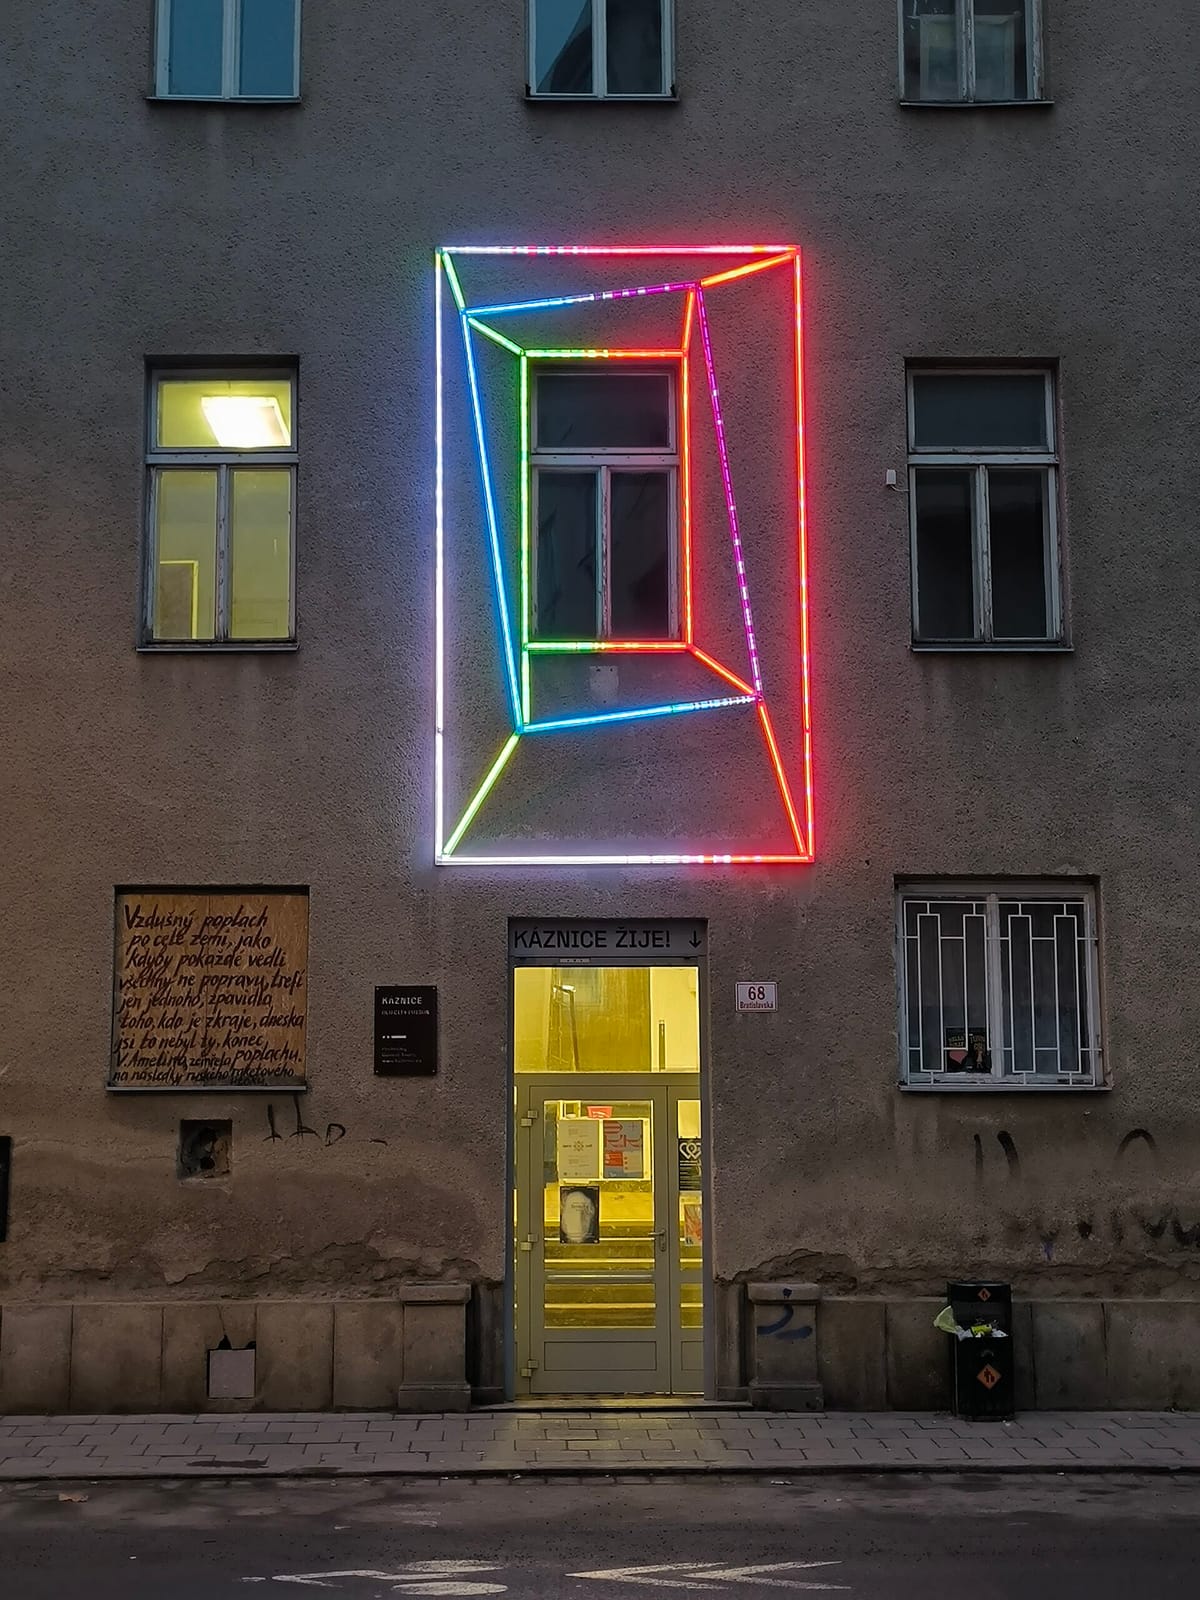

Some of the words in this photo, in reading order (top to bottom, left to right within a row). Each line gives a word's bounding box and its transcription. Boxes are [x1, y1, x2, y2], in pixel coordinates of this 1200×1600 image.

[125, 904, 196, 934] Vzdušný
[199, 904, 269, 937] poplach
[235, 928, 271, 951] jako
[513, 926, 607, 948] KÁZNICE
[615, 926, 671, 948] ŽIJE!
[125, 946, 174, 973] kdyby
[174, 944, 244, 976] pokaždé
[248, 947, 287, 968] vedli
[117, 993, 142, 1013] jen
[748, 986, 765, 1000] 68
[119, 1011, 156, 1030] toho,
[158, 1010, 183, 1029] kdo
[184, 1011, 201, 1033] je
[206, 1009, 257, 1033] zkraje,
[259, 1006, 306, 1030] dneska
[140, 1032, 157, 1049] to
